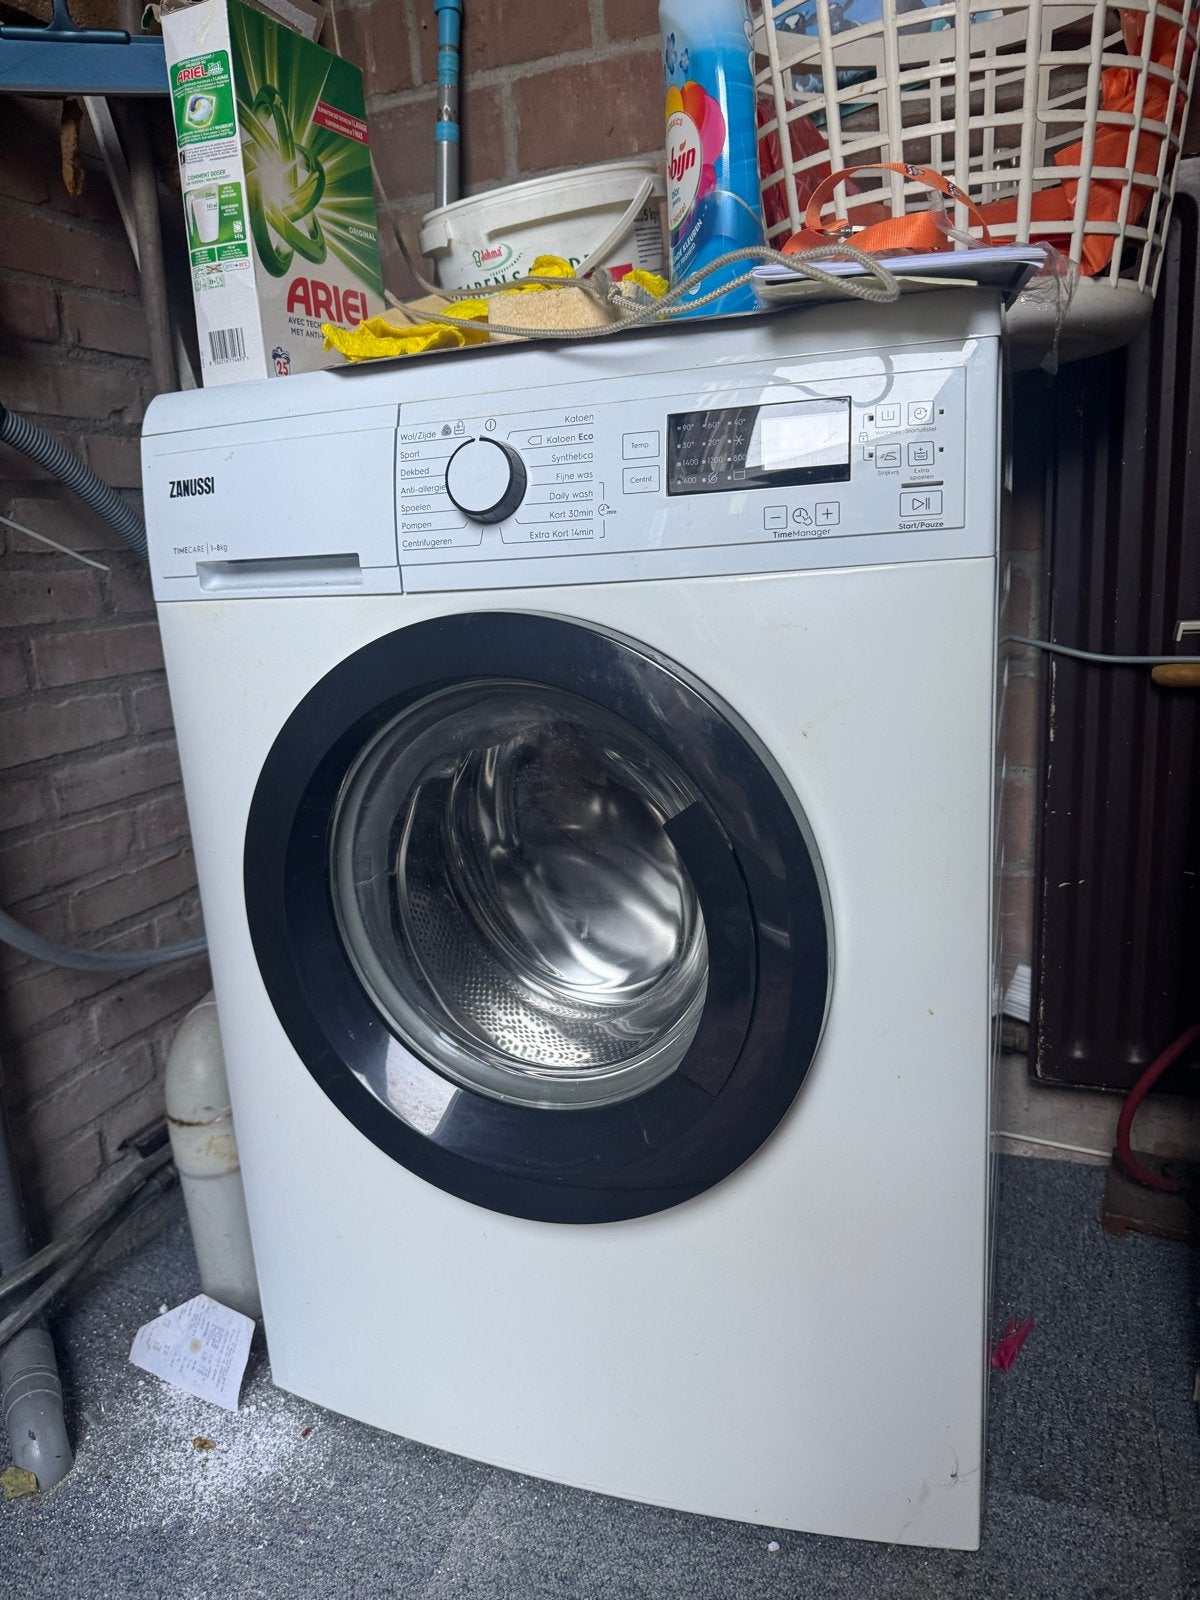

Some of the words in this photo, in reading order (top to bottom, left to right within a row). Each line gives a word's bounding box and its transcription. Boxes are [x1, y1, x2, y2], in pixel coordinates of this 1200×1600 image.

[177, 65, 208, 85] ARIEL
[667, 146, 696, 182] bijn
[348, 226, 377, 241] ORIGINAL
[682, 218, 703, 253] KLEUREN
[287, 277, 368, 326] ARIEL
[288, 317, 305, 326] AVEC
[290, 328, 304, 336] MET
[276, 361, 289, 376] 25
[564, 413, 594, 423] Katoen
[400, 431, 436, 441] Wol/Zijde
[546, 434, 576, 444] Katoen
[578, 433, 594, 441] Eco
[400, 451, 420, 460] Sport
[551, 451, 594, 463] Synthetica
[682, 458, 699, 466] 1400
[707, 456, 724, 464] 1200
[733, 454, 747, 462] 800
[400, 467, 430, 477] Dekbed
[556, 472, 575, 482] Fijne
[169, 476, 215, 498] ZANUSSI
[400, 483, 446, 494] Anti-allergie
[549, 491, 570, 501] Daily
[572, 490, 594, 498] wash
[400, 503, 432, 513] Spoelen
[549, 510, 566, 519] Kort
[568, 509, 594, 518] 30min
[401, 522, 432, 531] Pompen
[898, 521, 944, 531] Start/Pauze
[529, 531, 550, 540] Extra
[552, 529, 569, 538] Kort
[571, 528, 594, 537] 14min
[772, 528, 831, 539] TimeManager
[402, 538, 453, 549] Centrifugeren
[173, 545, 205, 555] TIMECARE
